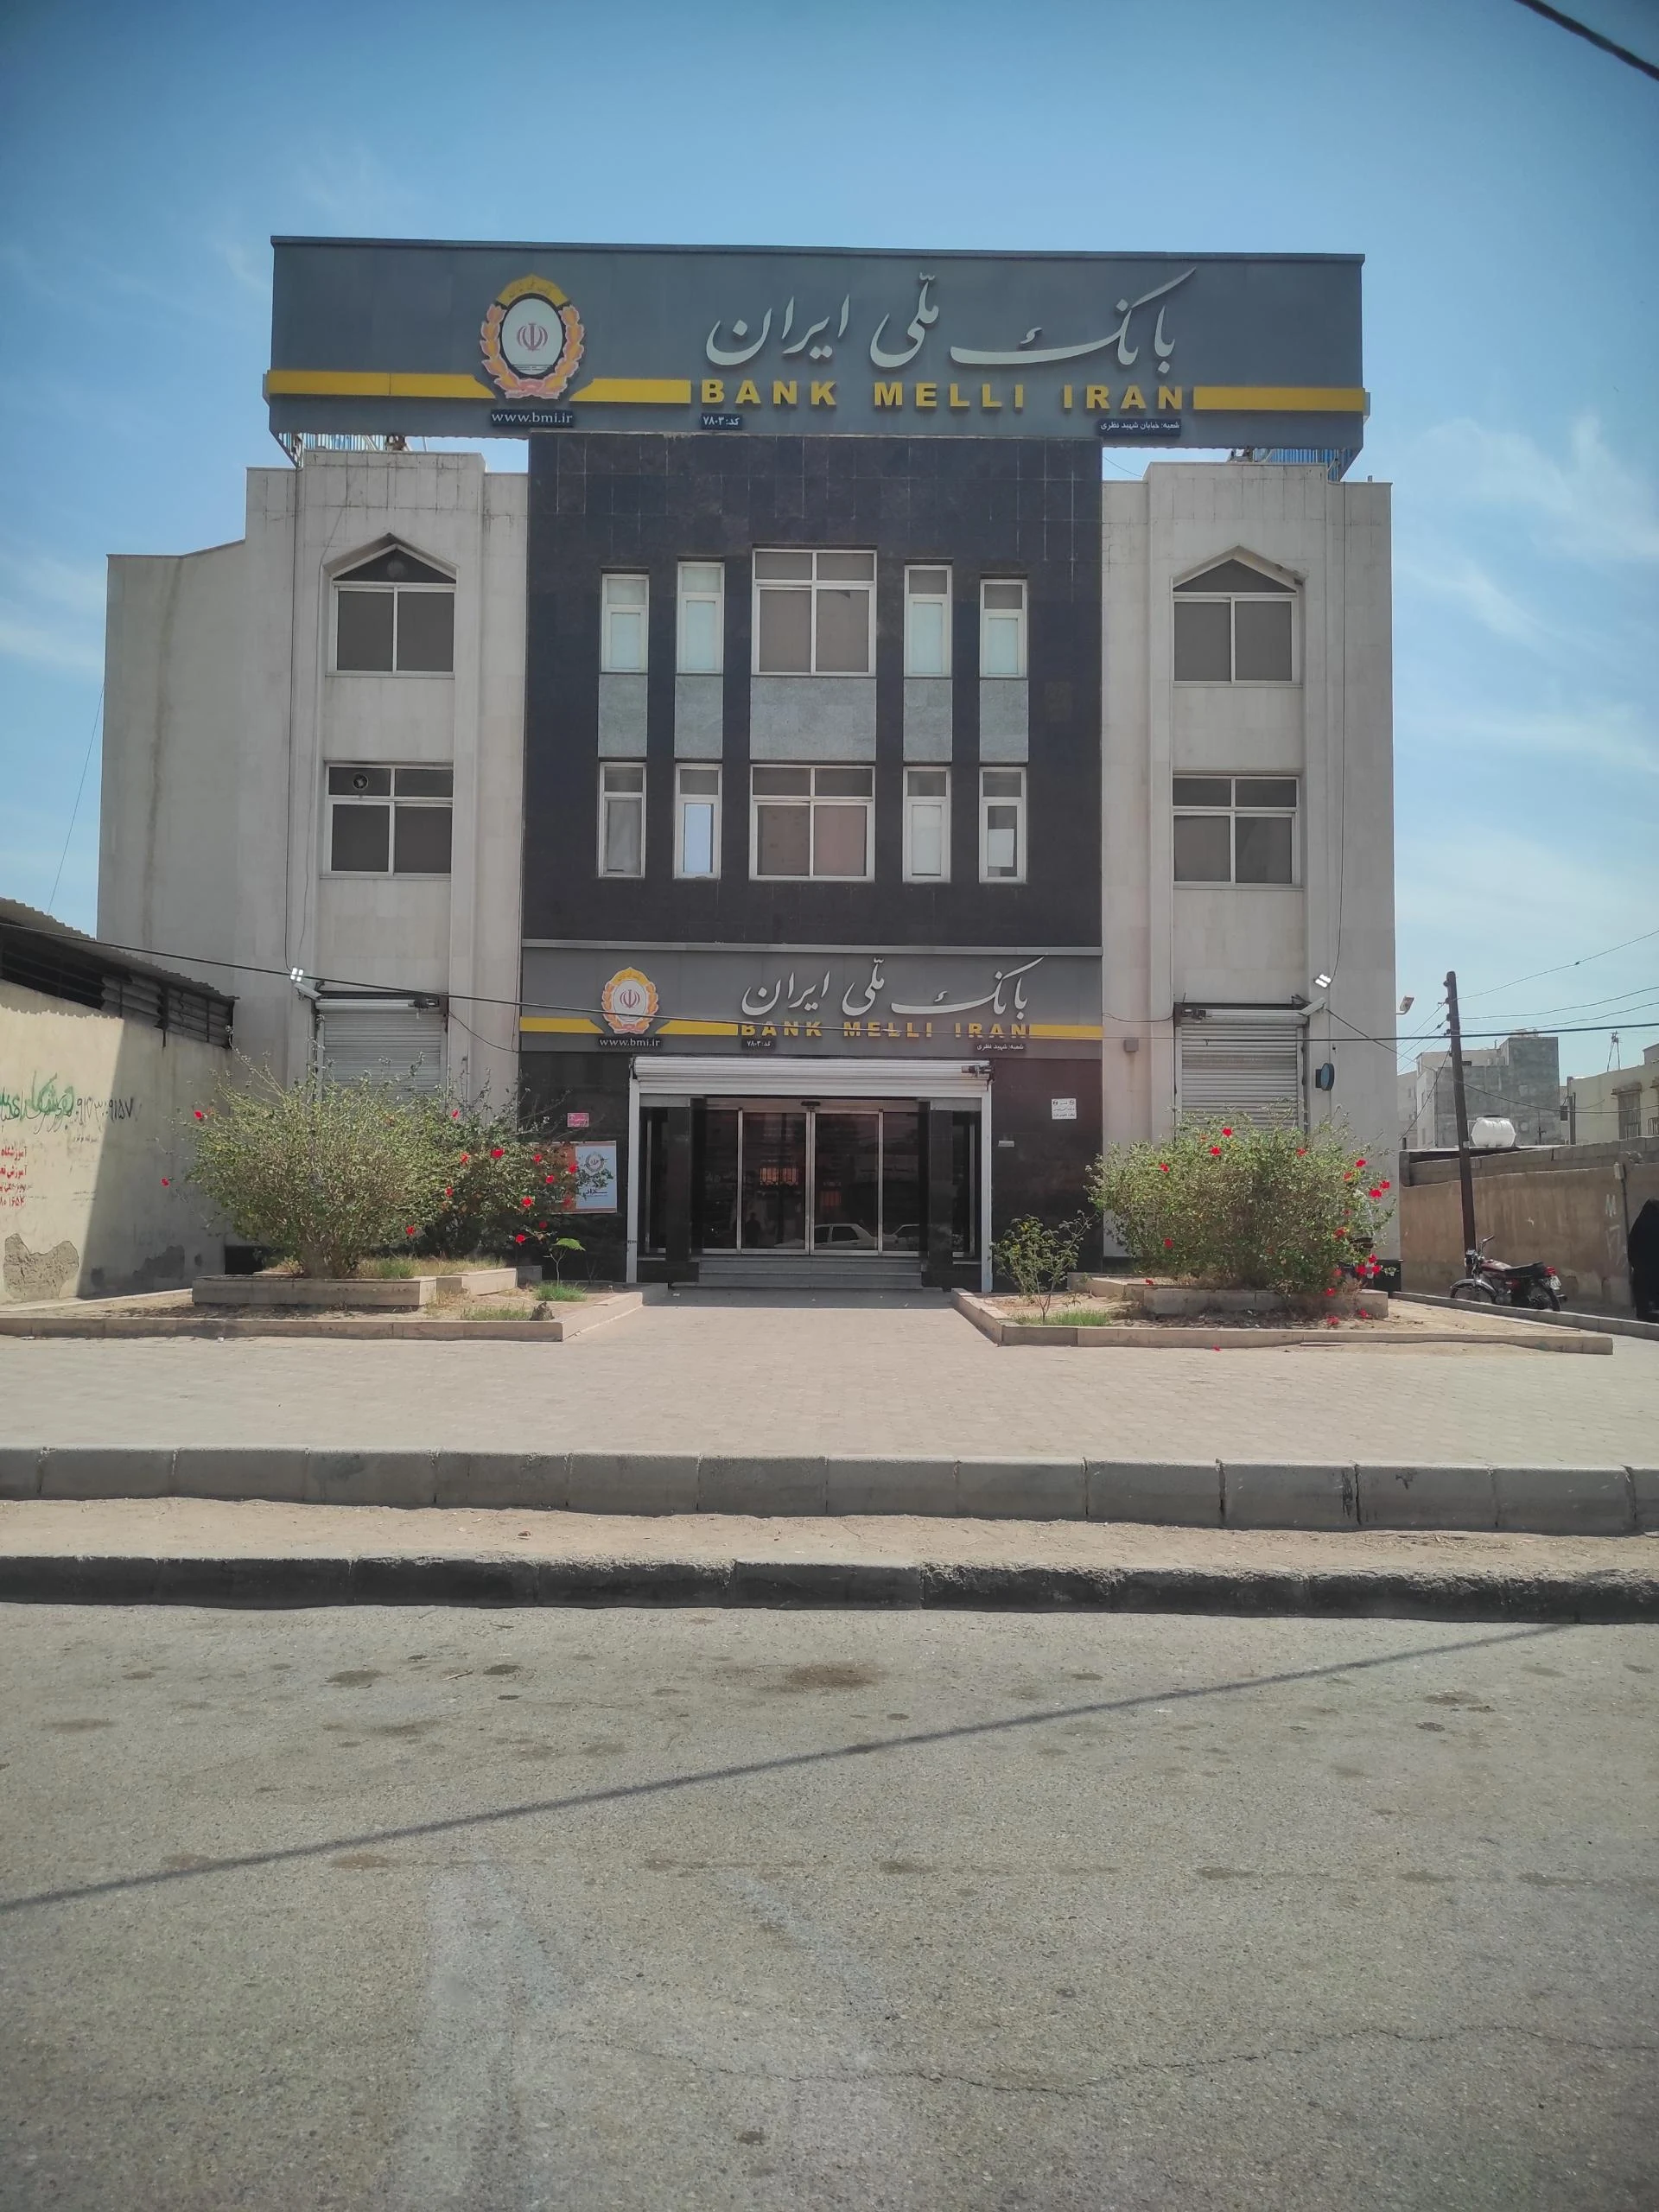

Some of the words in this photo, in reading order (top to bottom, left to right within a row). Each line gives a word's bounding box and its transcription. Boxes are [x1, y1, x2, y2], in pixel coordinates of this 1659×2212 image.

[705, 294, 849, 365] ایران
[701, 378, 837, 406] BANK
[874, 382, 1024, 409] MELLI
[1063, 385, 1183, 410] IRAN
[492, 411, 573, 423] www.bmi.ir
[1100, 421, 1120, 431] نظری
[1121, 421, 1139, 430] شهید
[1140, 421, 1160, 431] خیابان
[741, 970, 830, 1016] ایران
[741, 1020, 823, 1037] BANK
[843, 1021, 932, 1038] MELLI
[955, 1022, 1027, 1039] IRAN
[600, 1038, 661, 1046] www.bmi.ir
